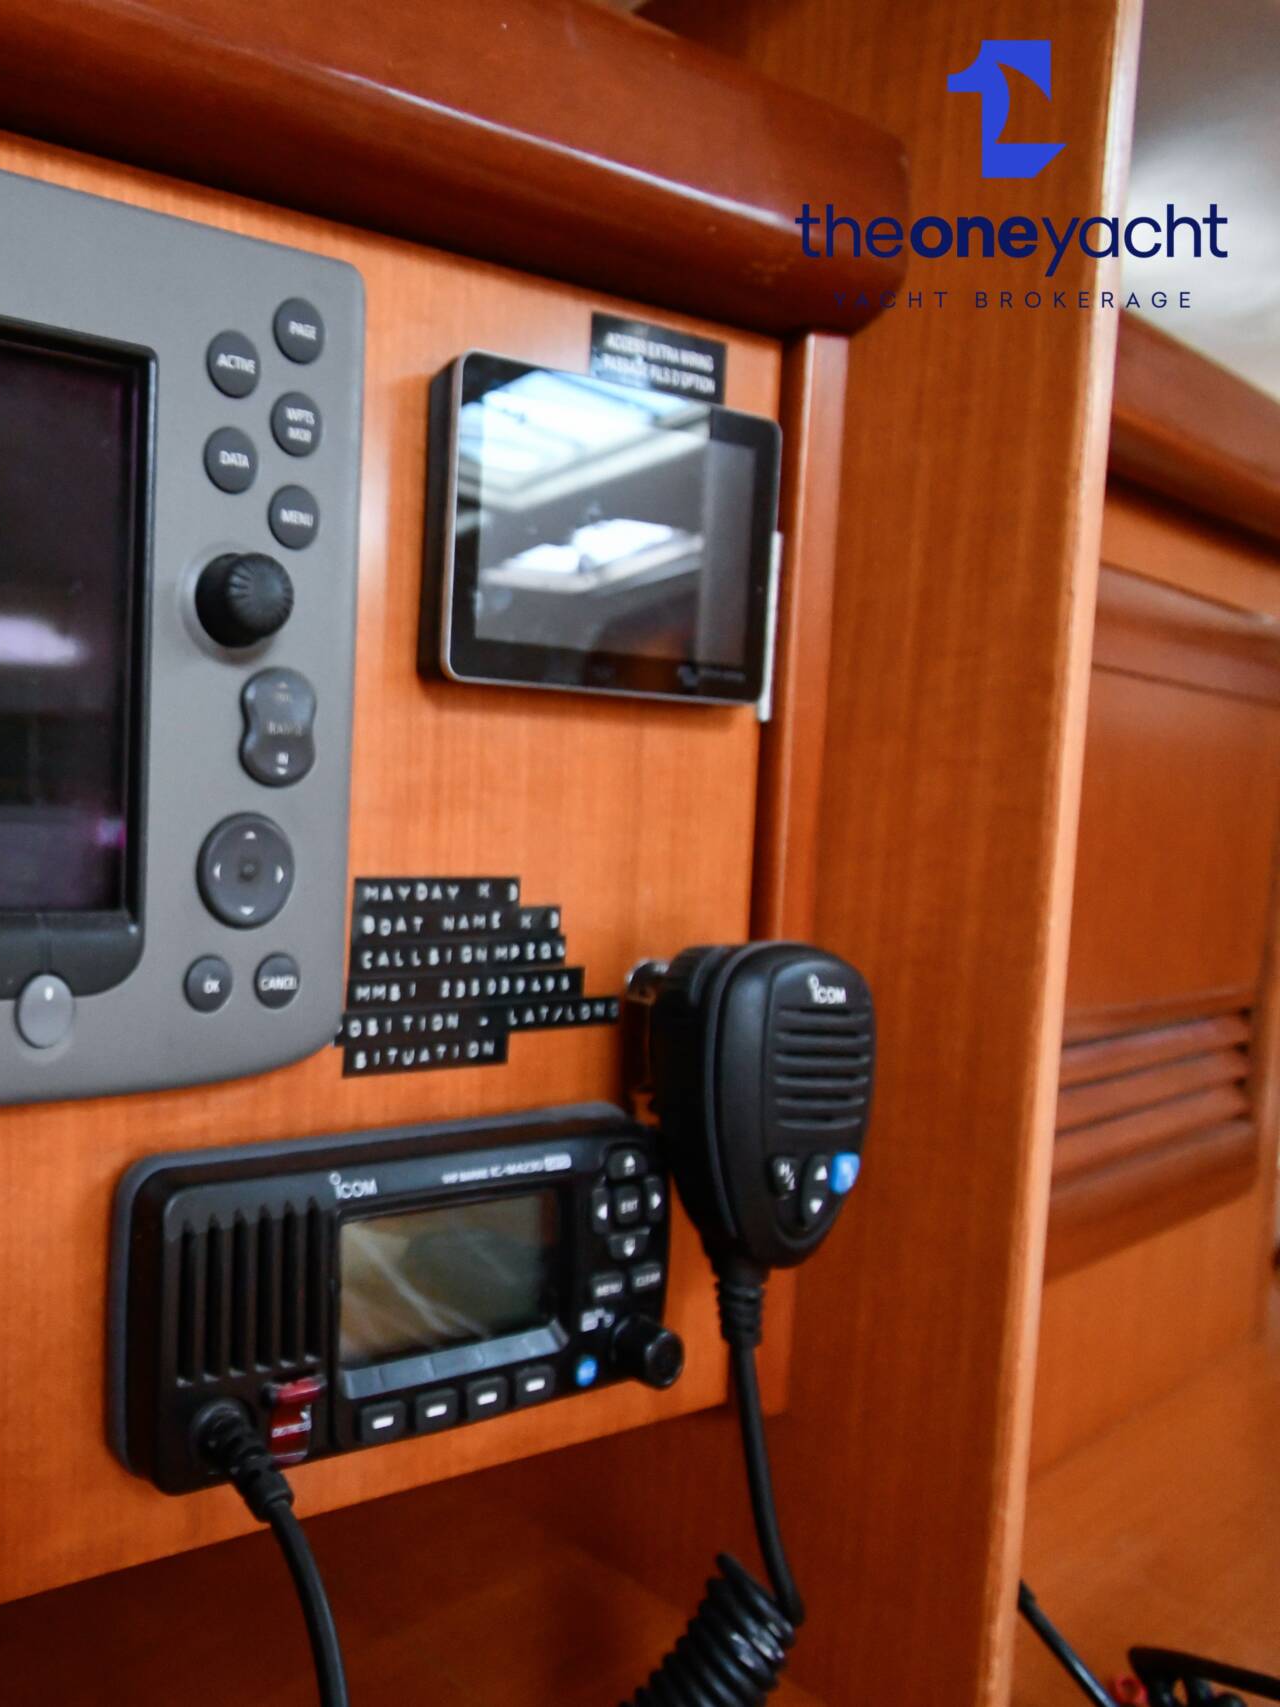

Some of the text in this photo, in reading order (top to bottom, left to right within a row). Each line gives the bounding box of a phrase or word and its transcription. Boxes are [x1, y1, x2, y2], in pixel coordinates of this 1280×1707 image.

[288, 320, 317, 341] PAGE
[217, 353, 256, 374] ACTIVE
[219, 450, 250, 468] DATA
[280, 508, 314, 528] MENU
[277, 752, 289, 765] IN
[364, 882, 459, 901] MAYDAY
[362, 914, 424, 936] BOAT
[442, 911, 501, 931] NAME
[203, 978, 221, 993] OK
[260, 975, 298, 991] CANCEL
[337, 1011, 460, 1038] OSITION
[354, 1040, 495, 1069] SITUATION
